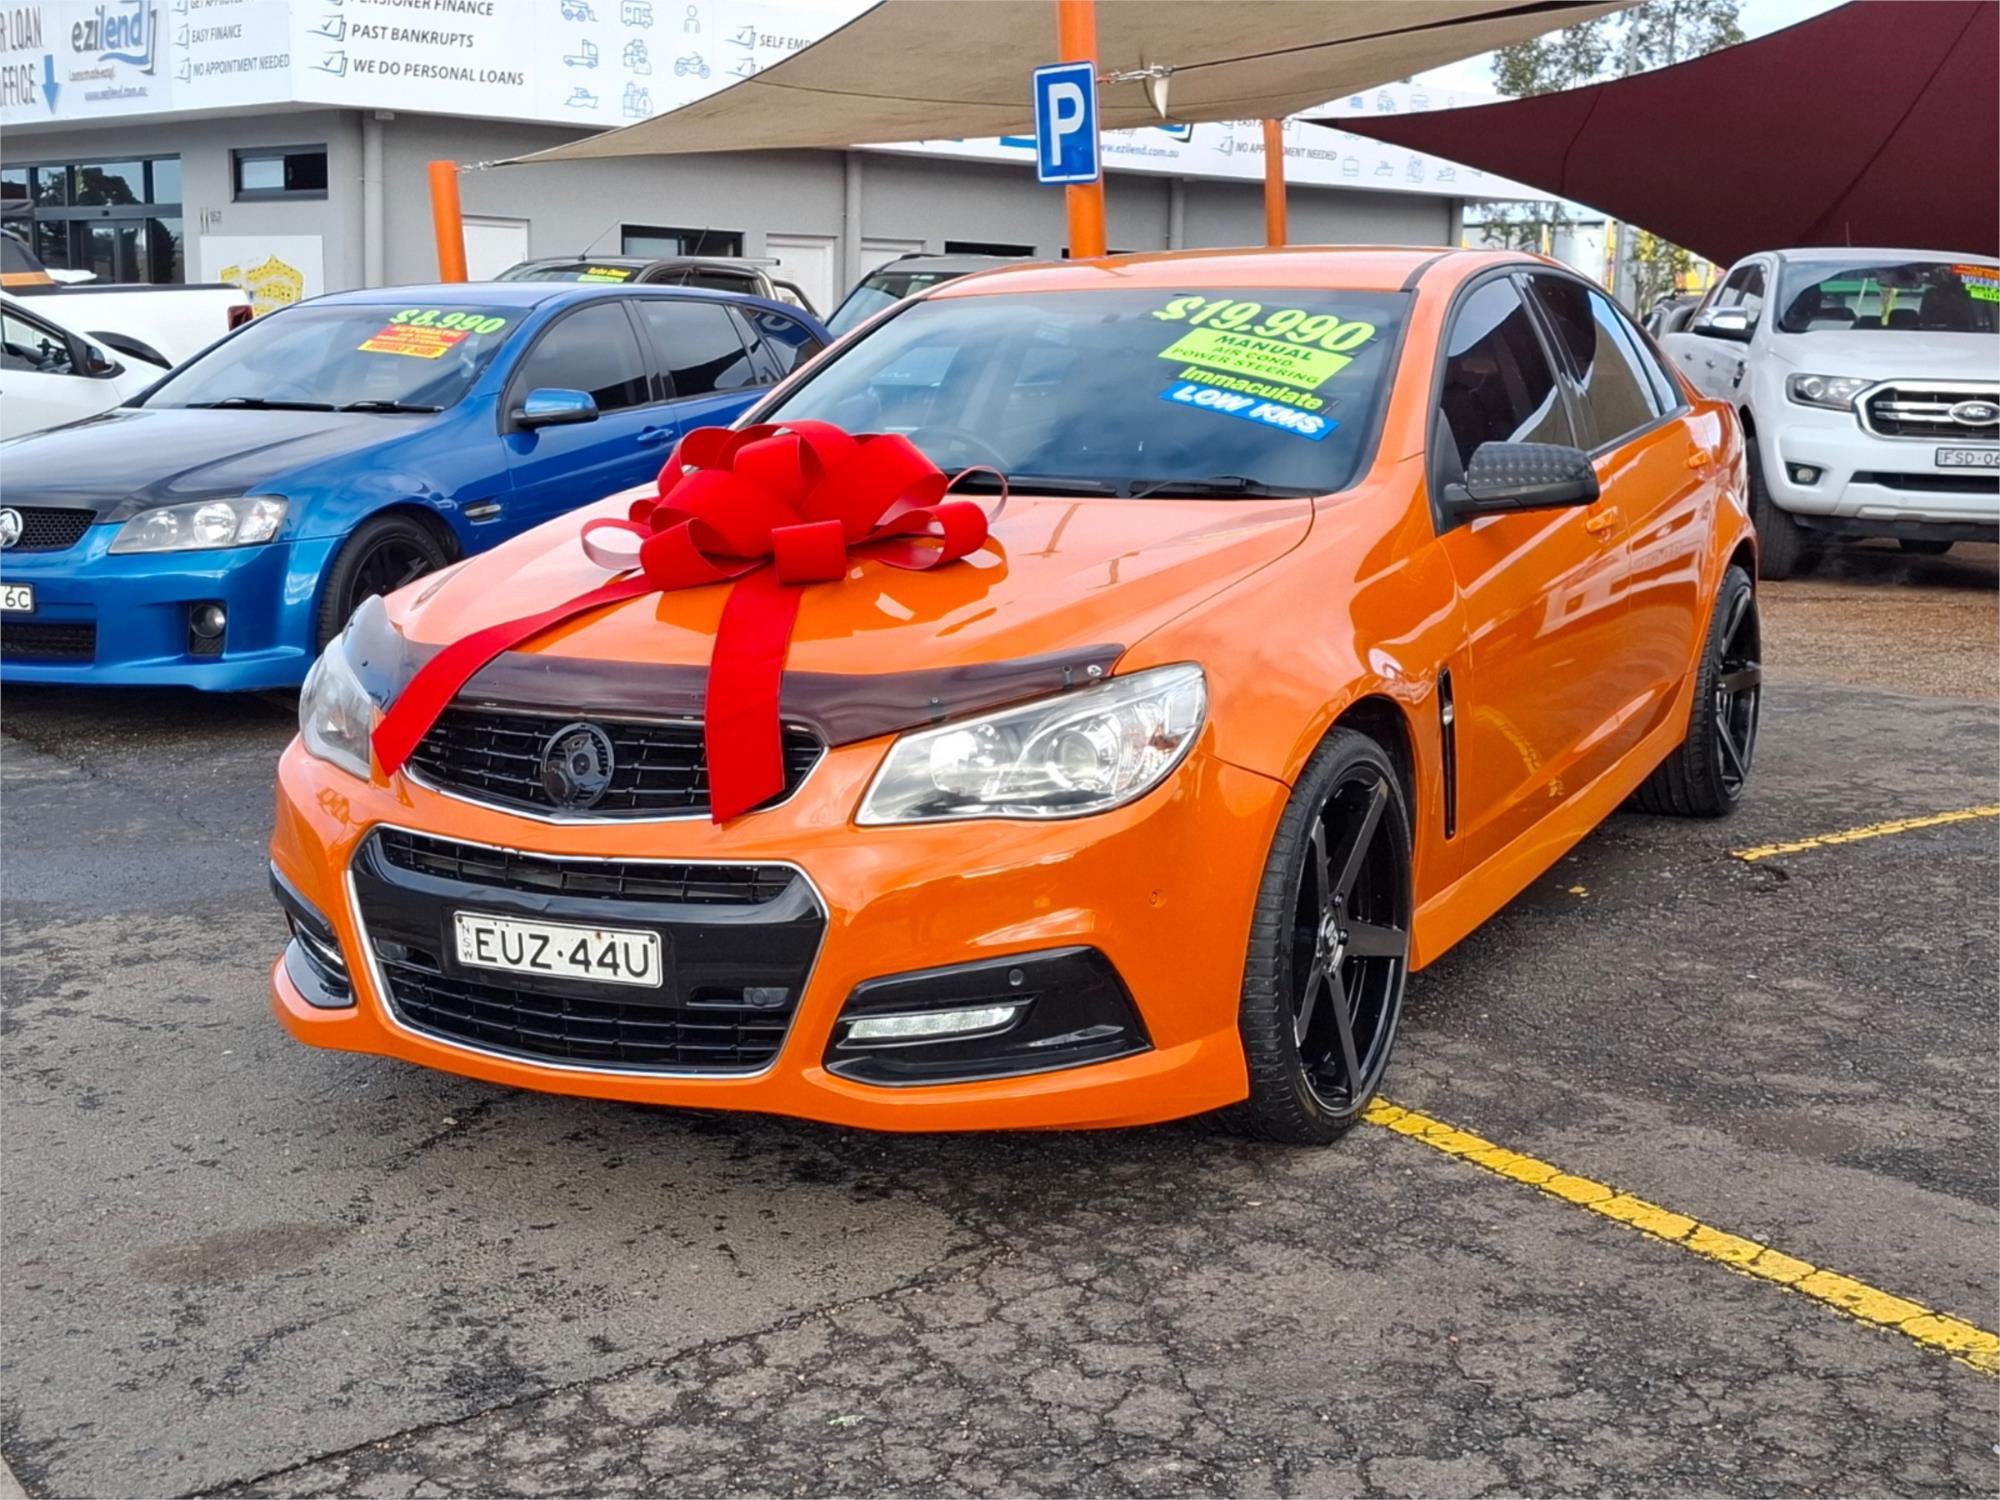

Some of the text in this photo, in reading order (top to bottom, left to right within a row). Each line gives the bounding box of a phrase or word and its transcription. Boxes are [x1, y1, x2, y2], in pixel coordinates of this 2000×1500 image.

[433, 0, 494, 16] FINANCE
[9, 6, 43, 52] LOAN
[72, 5, 144, 53] ezilend
[192, 24, 242, 43] EASY FINANCE
[352, 24, 474, 48] PAST BANKRUPTS
[760, 34, 785, 49] SELF
[193, 53, 290, 76] NO APPOINTMENT NEEDED
[353, 59, 525, 86] WE DO PERSONAL LOANS
[1048, 81, 1085, 166] P
[1236, 143, 1249, 153] NO
[1306, 148, 1337, 161] NEEDED
[1212, 346, 1242, 357] AIR
[1214, 335, 1312, 361] MANUAL
[1171, 347, 1320, 384] POWER STEERING
[1179, 366, 1324, 410] Immaculate
[1172, 385, 1325, 434] LOW KMS
